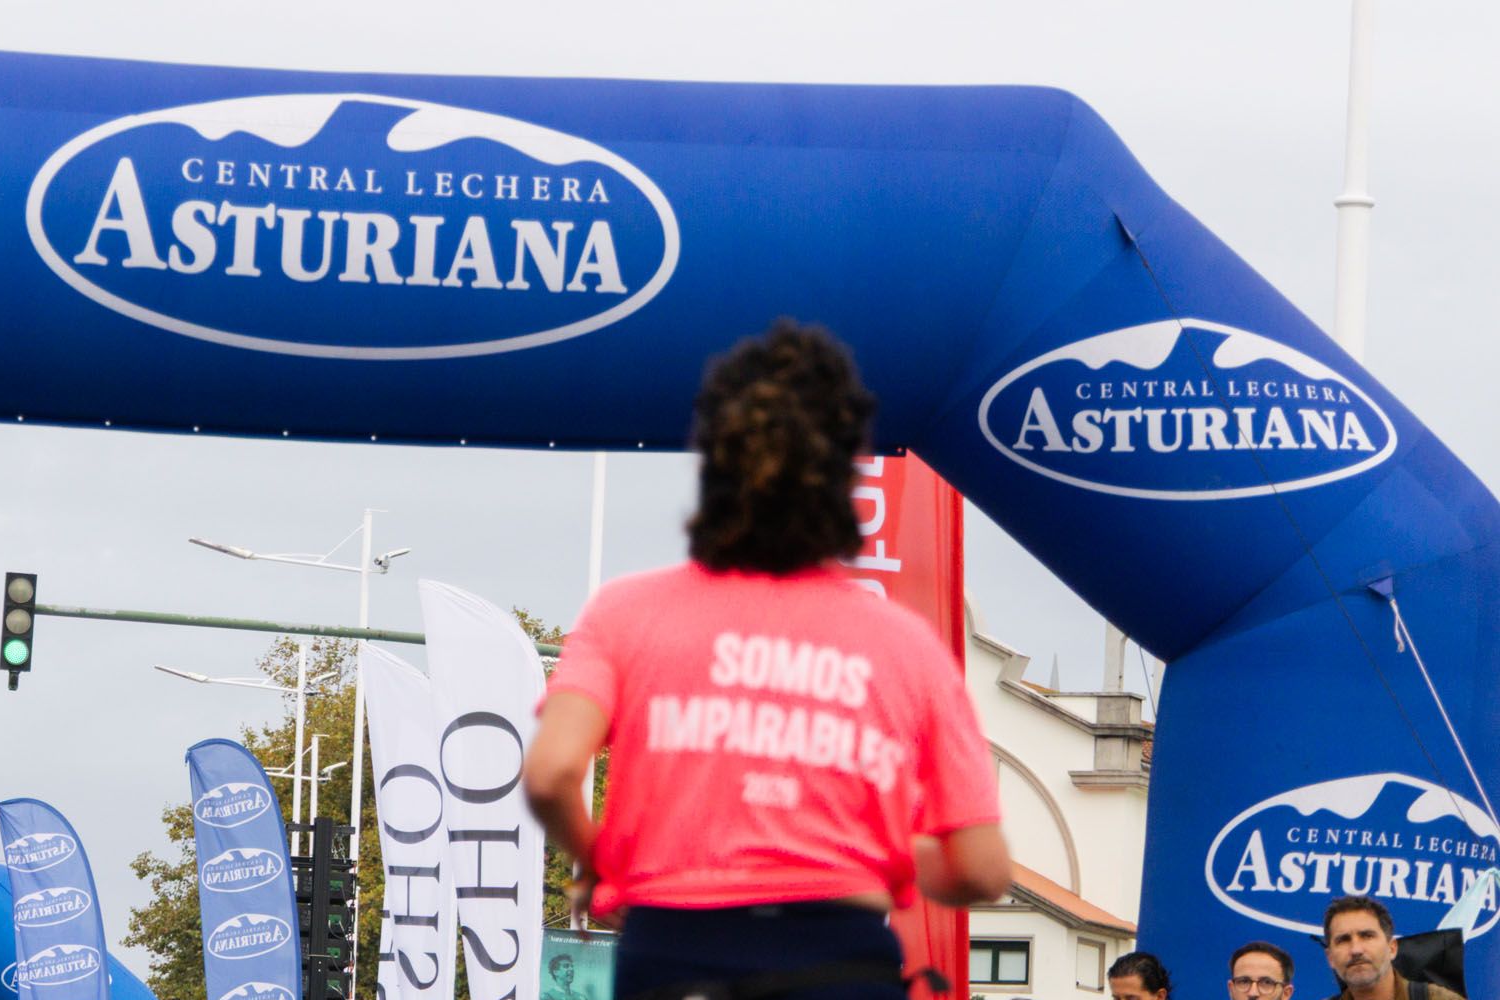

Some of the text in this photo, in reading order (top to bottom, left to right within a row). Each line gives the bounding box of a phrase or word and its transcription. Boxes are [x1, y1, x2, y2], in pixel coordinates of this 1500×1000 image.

[181, 157, 610, 204] CENTRAL LECHERA
[73, 157, 628, 294] ASTURIANA
[1013, 387, 1376, 453] ASTURIANA
[1076, 380, 1351, 404] CENTRAL LECHERA
[710, 631, 872, 708] SOMOS
[1286, 827, 1497, 862] CENTRAL LECHERA
